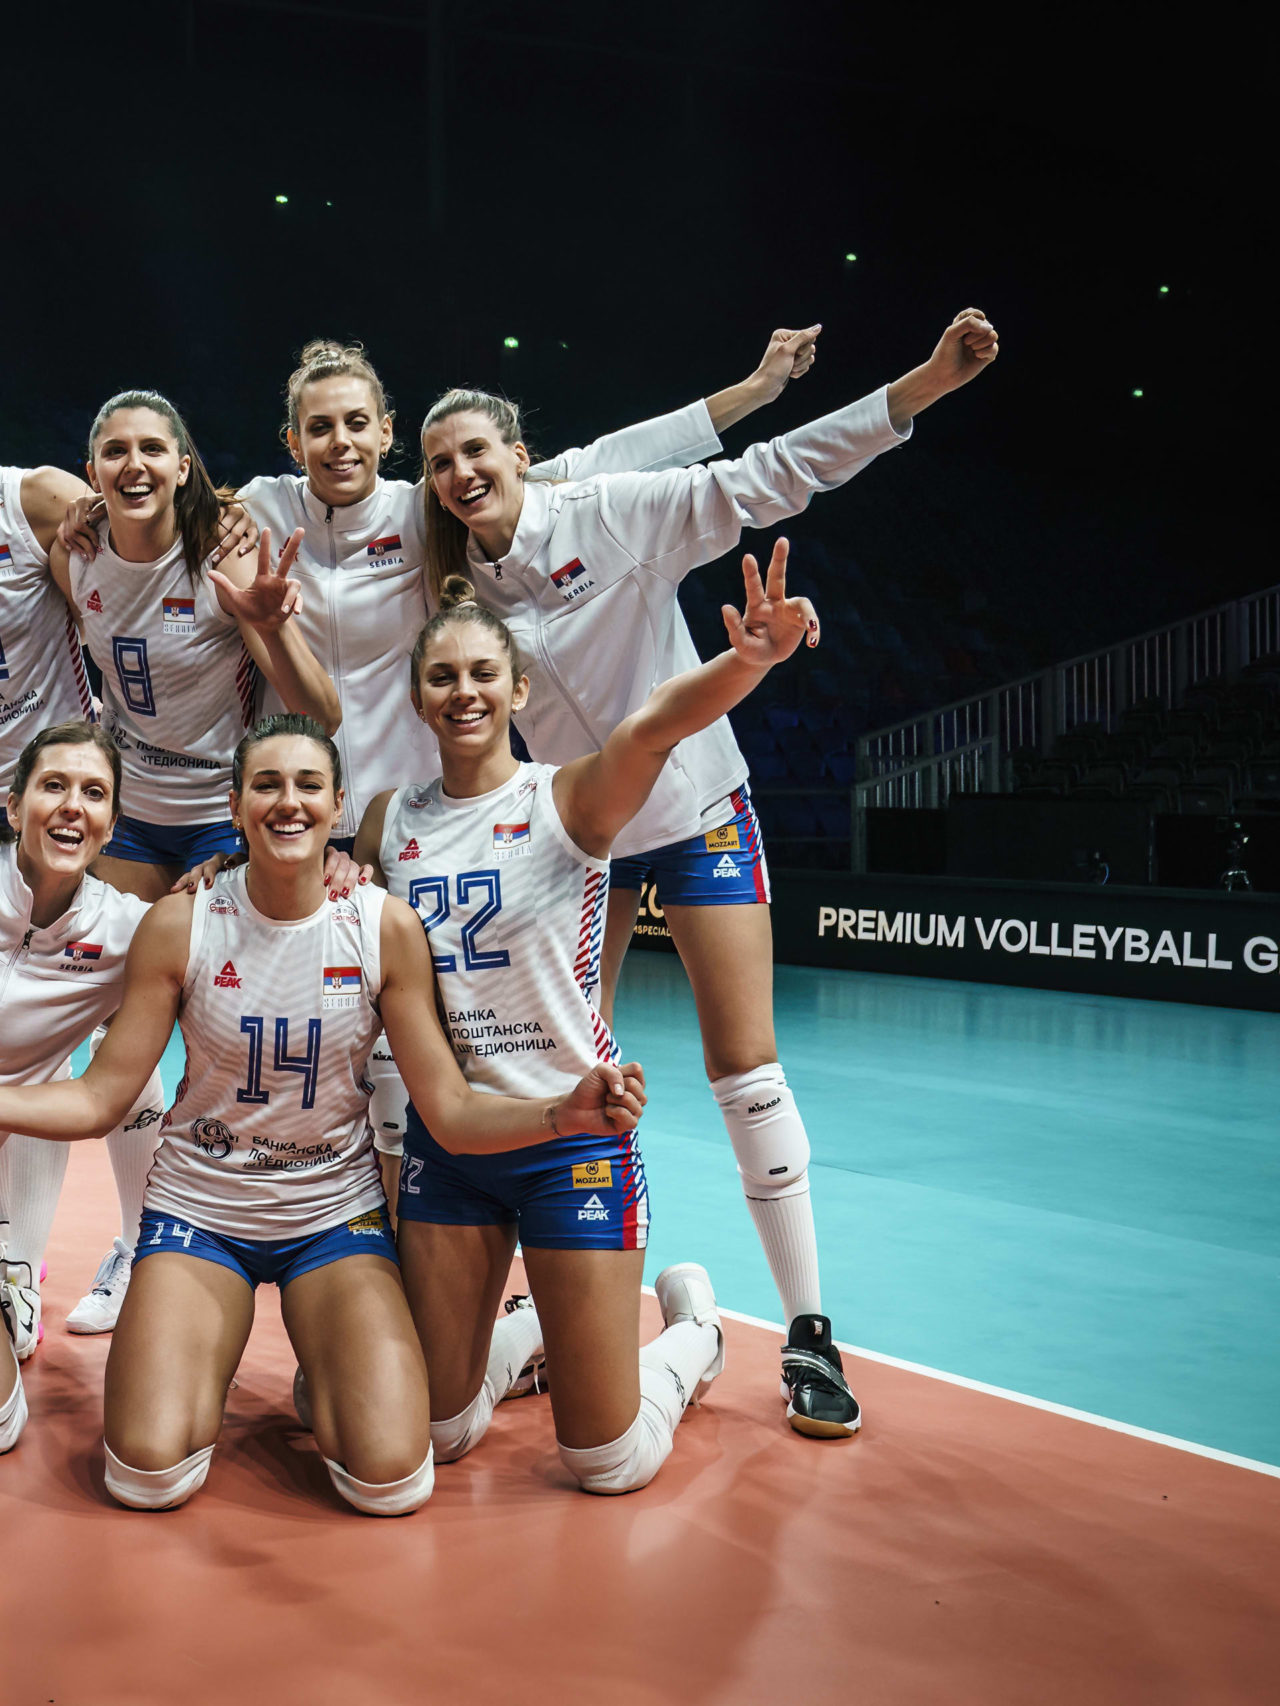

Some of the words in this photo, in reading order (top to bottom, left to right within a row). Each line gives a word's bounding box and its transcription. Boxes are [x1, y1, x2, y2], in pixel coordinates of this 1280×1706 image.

[369, 558, 404, 569] SERBIA
[563, 580, 595, 601] SERBIA
[112, 636, 157, 717] 8
[709, 841, 738, 849] MOZZART
[398, 850, 423, 862] PEAK
[713, 868, 741, 878] PEAK
[409, 869, 511, 974] 22
[818, 906, 966, 949] PREMIUM
[974, 916, 1233, 970] VOLLEYBALL
[1243, 936, 1280, 974] G
[59, 964, 94, 973] SERBIA
[214, 976, 242, 989] PEAK
[448, 1009, 496, 1023] БАНКА
[452, 1022, 543, 1039] ПОШТАНСКА
[456, 1037, 557, 1058] ШТЕДИОНИЦА
[236, 1015, 321, 1110] 14
[252, 1136, 298, 1151] БАНКА
[575, 1176, 610, 1184] MOZZART
[578, 1209, 610, 1221] PEAK
[149, 1222, 195, 1248] 14
